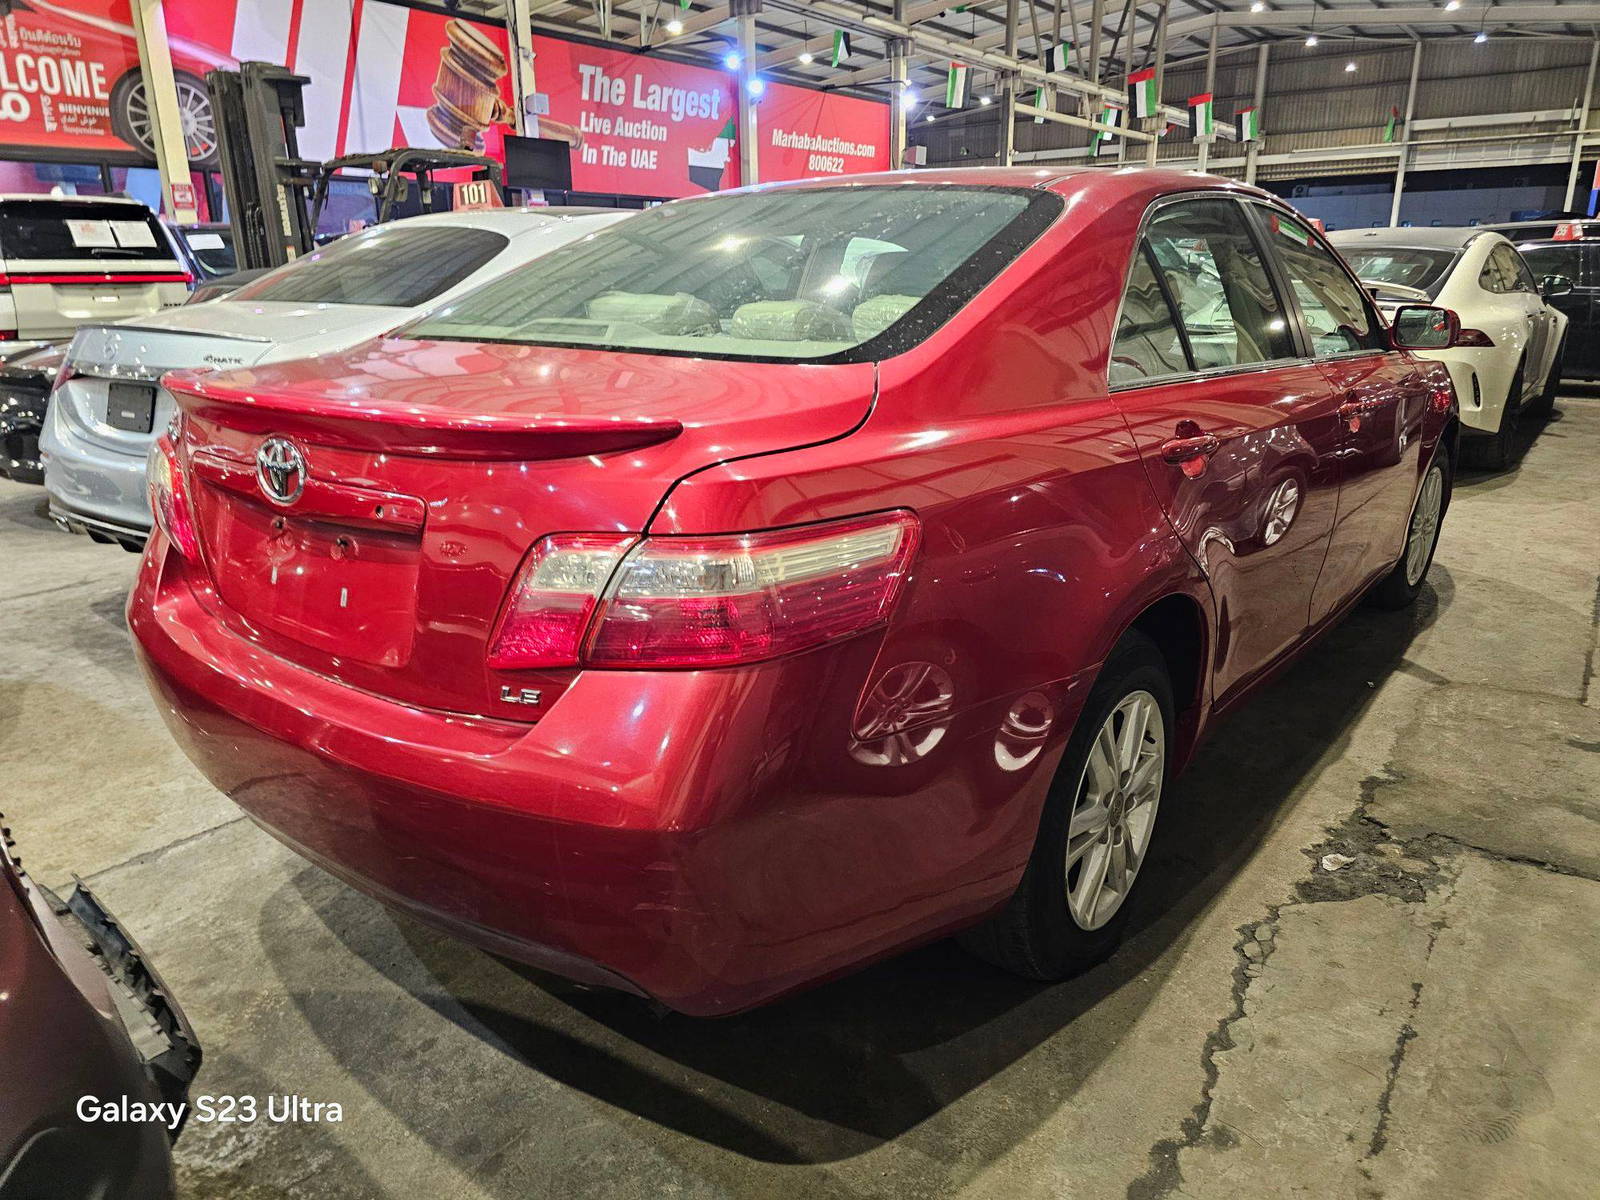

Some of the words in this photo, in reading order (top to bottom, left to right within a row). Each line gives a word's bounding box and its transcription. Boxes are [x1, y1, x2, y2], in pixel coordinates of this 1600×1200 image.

[579, 63, 626, 106] The
[633, 72, 722, 123] Largest
[580, 111, 612, 136] Live
[613, 115, 668, 142] Auction
[771, 127, 876, 159] MarhabaAuctions.com
[582, 144, 598, 165] In
[601, 146, 628, 168] The
[630, 149, 659, 170] UAE
[808, 153, 845, 174] 800622
[461, 183, 487, 206] 101
[500, 685, 541, 705] LE
